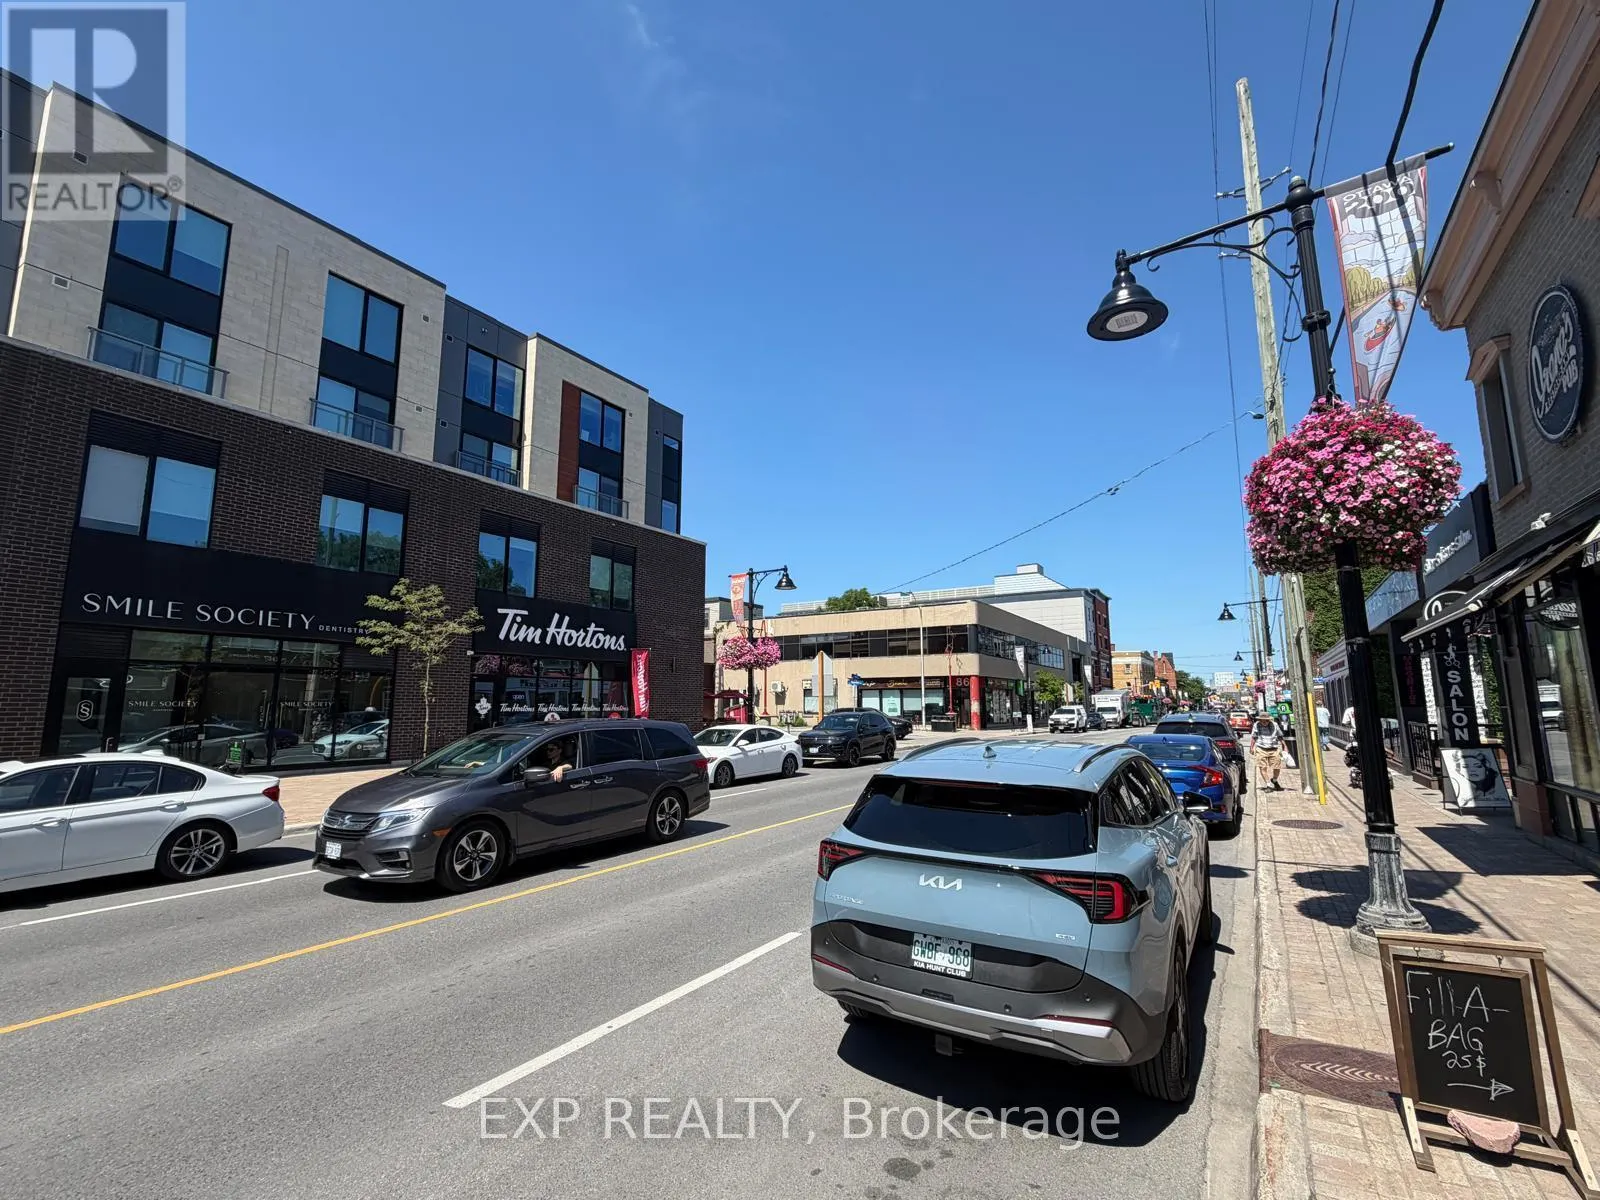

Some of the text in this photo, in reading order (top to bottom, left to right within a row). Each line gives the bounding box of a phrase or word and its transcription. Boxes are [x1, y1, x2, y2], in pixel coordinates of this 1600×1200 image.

[81, 592, 184, 621] SMILE
[195, 604, 316, 631] SOCIETY
[497, 608, 624, 651] Tim Hortons
[159, 700, 198, 708] SOCIETY
[500, 703, 535, 712] Tim Hortons
[548, 704, 569, 712] Hortons
[1446, 670, 1470, 741] SALON
[919, 873, 962, 890] KIA
[913, 939, 970, 968] GWBF 968
[913, 960, 967, 977] KIA HUNT CLUB
[1428, 1018, 1485, 1055] BAG
[1442, 1050, 1487, 1077] 25$
